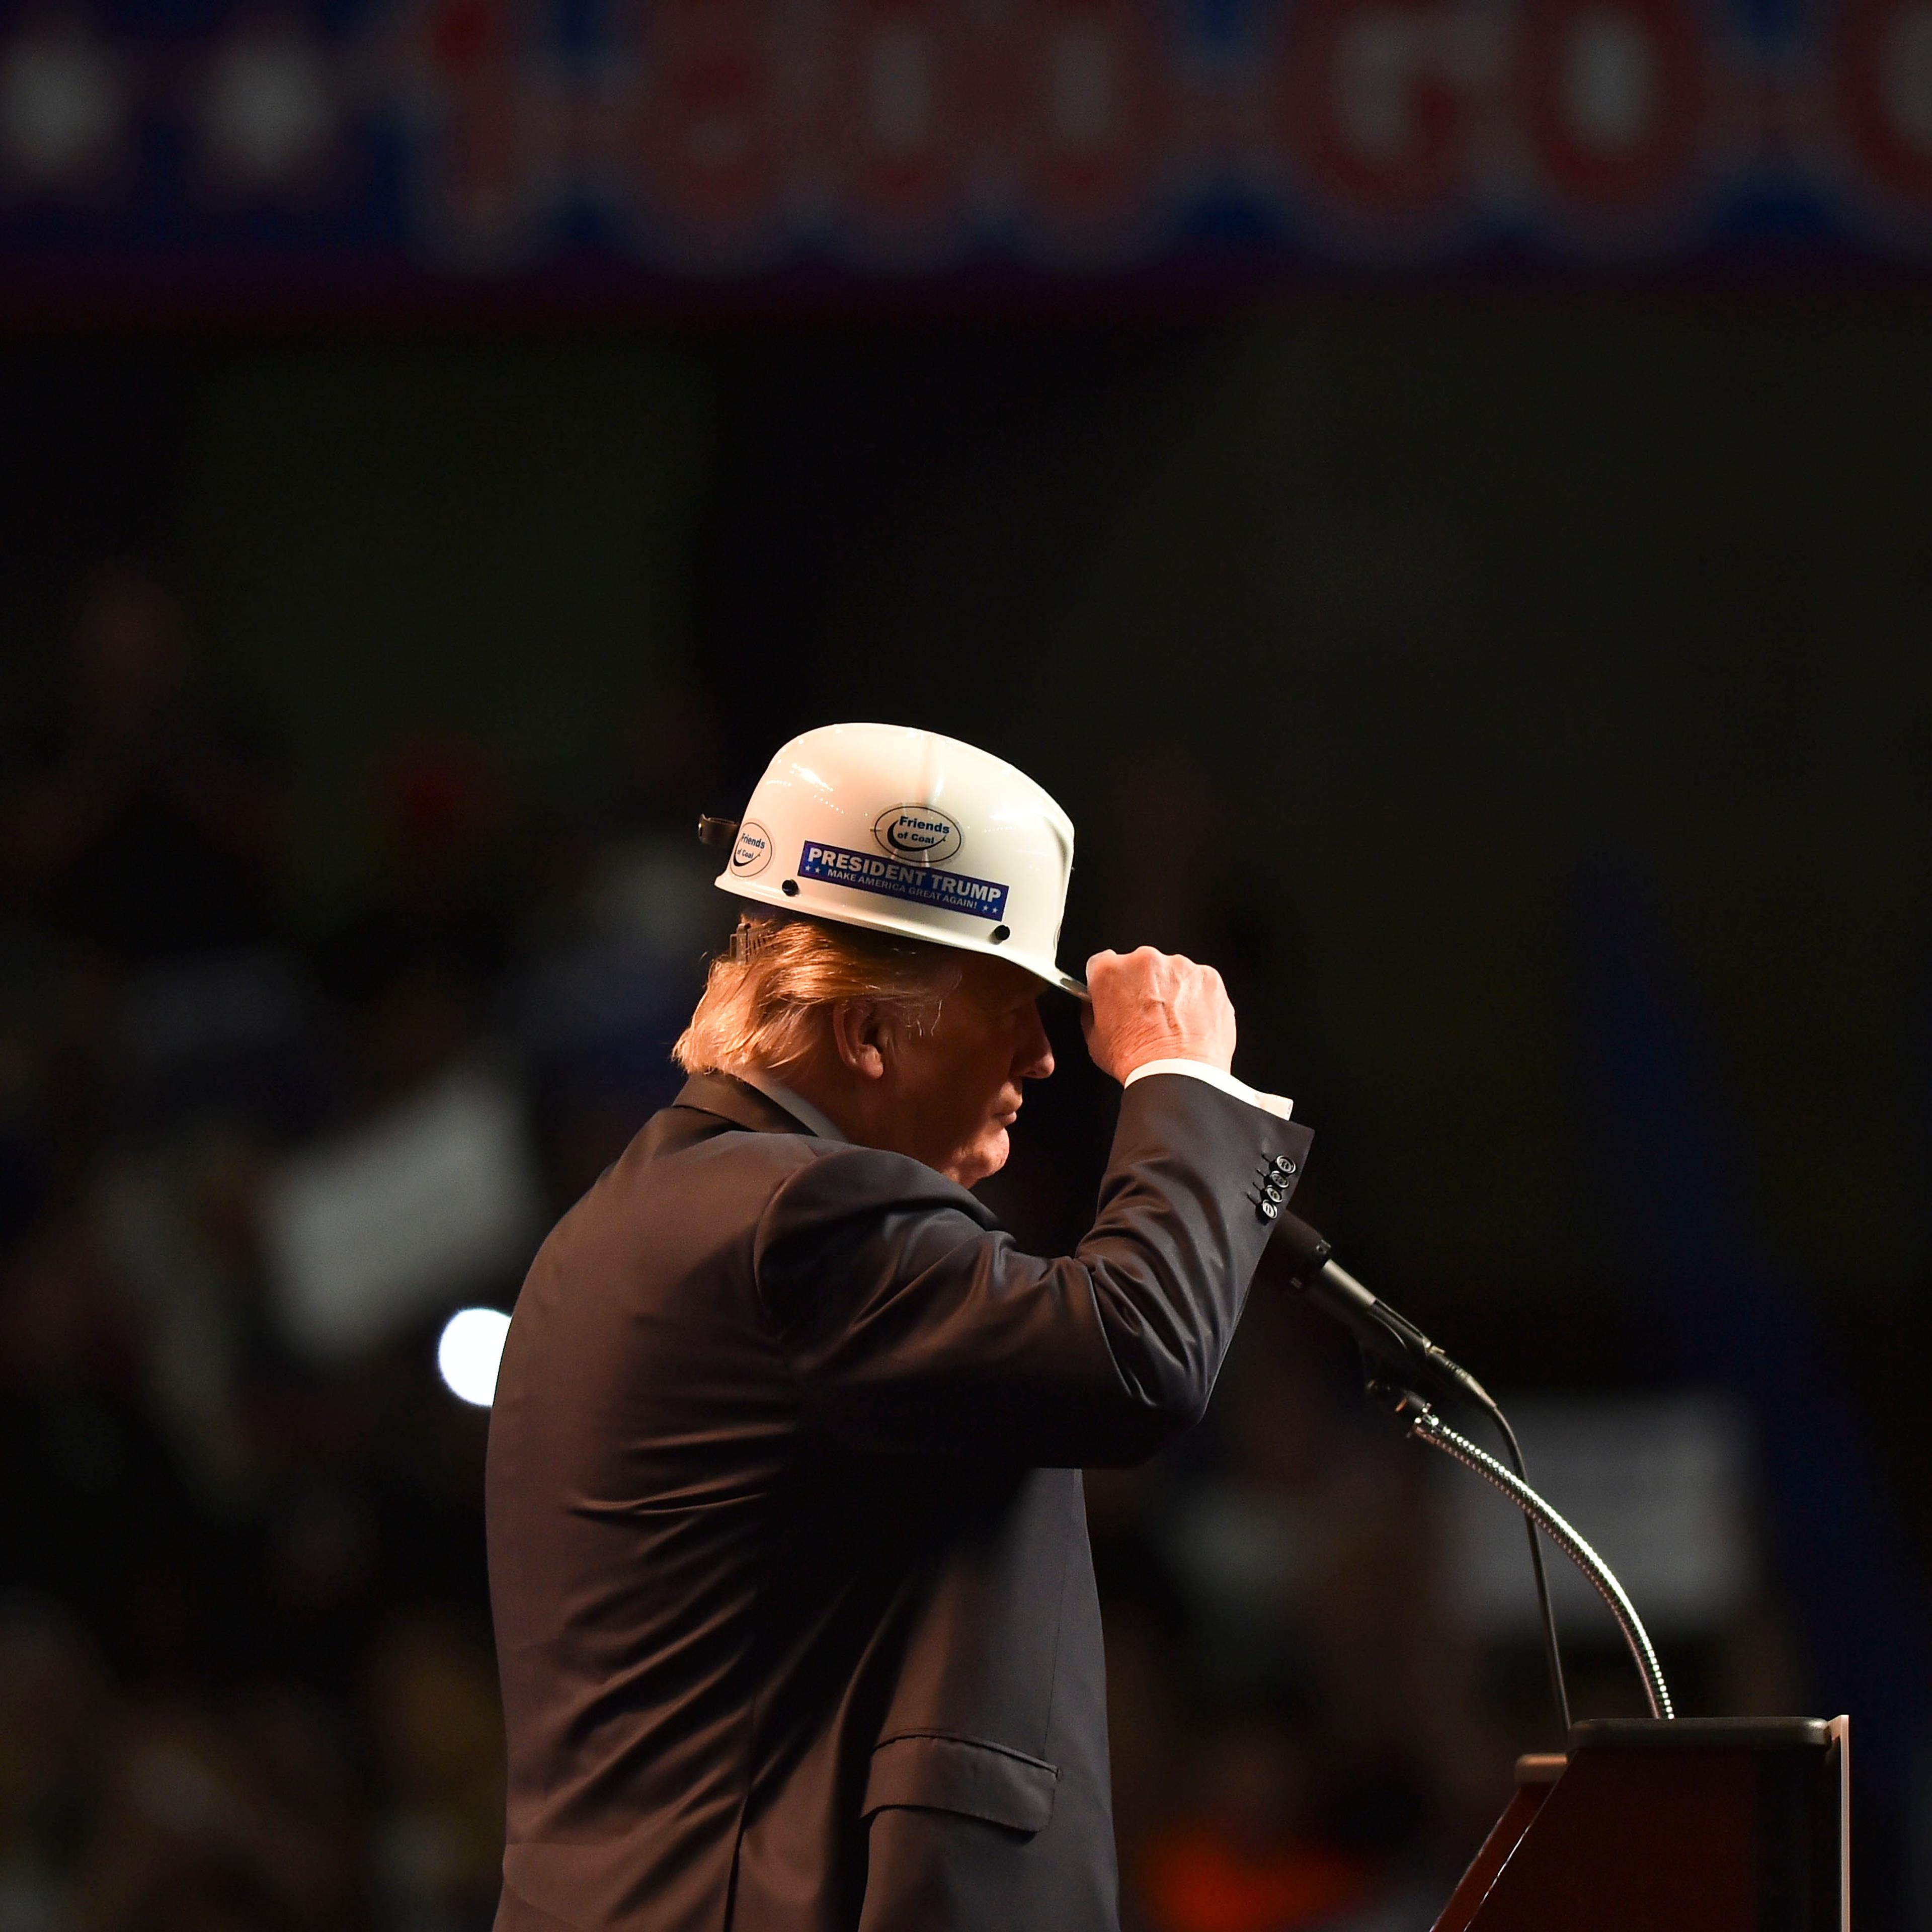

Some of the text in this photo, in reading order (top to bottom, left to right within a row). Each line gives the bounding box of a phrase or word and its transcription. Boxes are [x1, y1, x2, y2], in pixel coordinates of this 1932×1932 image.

[899, 816, 950, 834] Friends
[741, 833, 766, 849] Friends
[897, 832, 935, 844] of Coal
[742, 850, 754, 859] Coal
[808, 847, 1001, 903] PRESIDENT TRUMP
[827, 868, 978, 910] MAKE AMERICA GREAT AGAIN!
